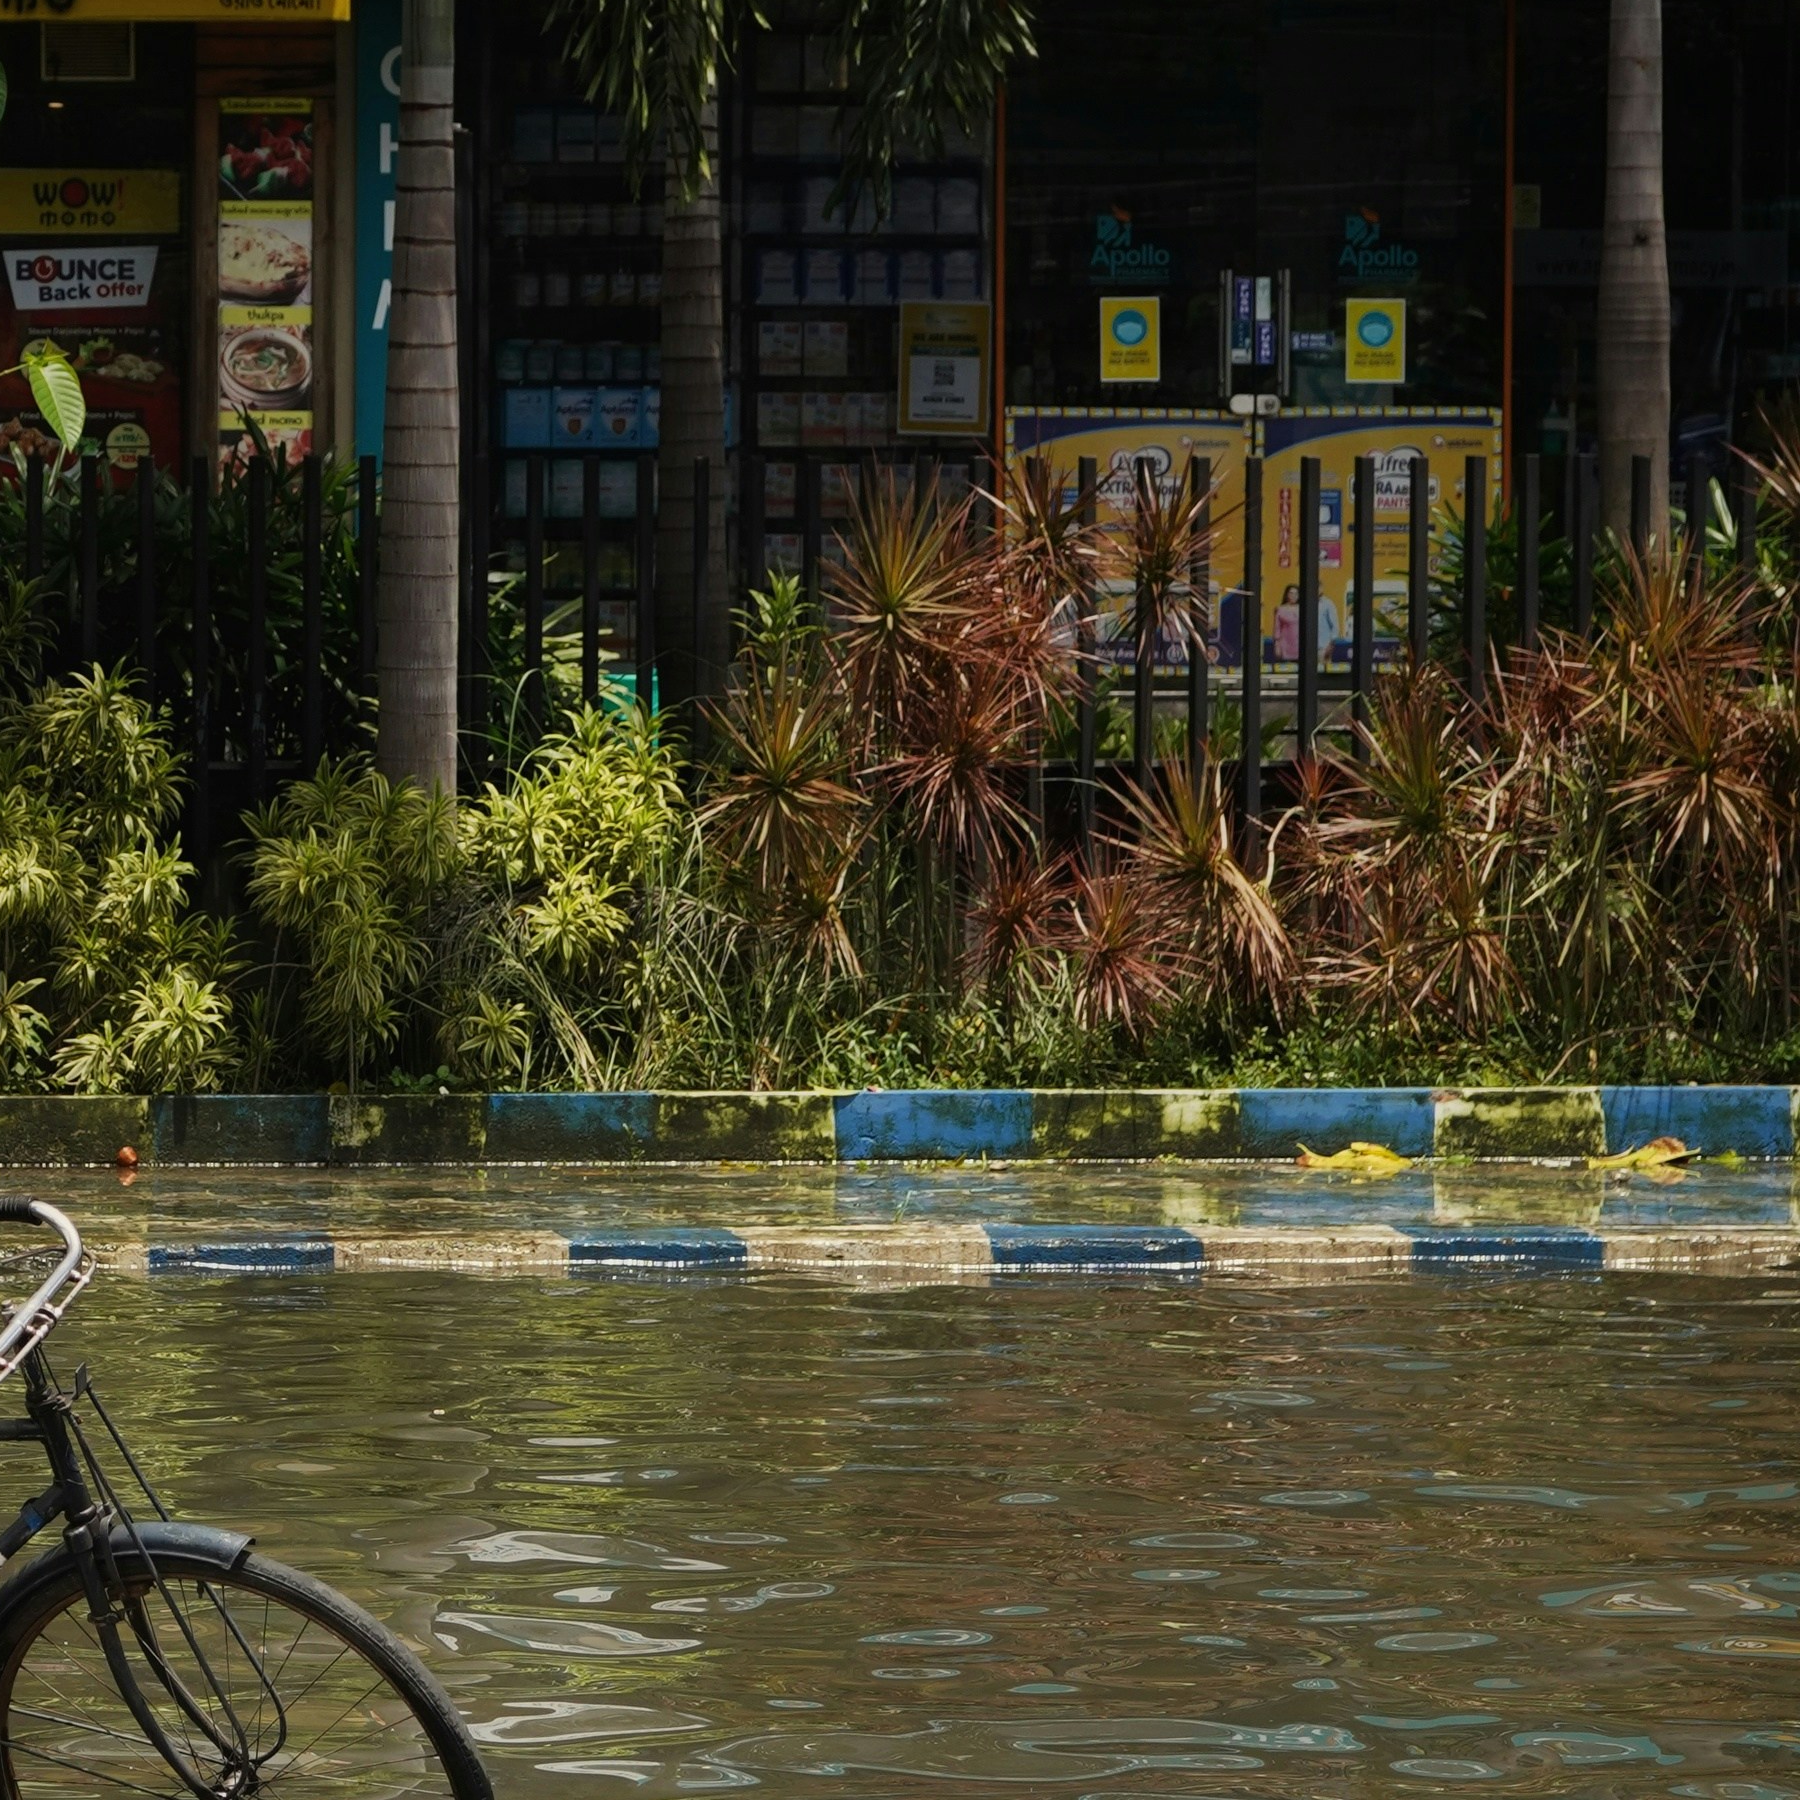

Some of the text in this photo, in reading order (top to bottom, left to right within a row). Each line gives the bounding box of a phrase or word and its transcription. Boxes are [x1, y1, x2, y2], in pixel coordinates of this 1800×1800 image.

[32, 177, 125, 210] WOW!
[39, 210, 117, 226] momo
[15, 255, 136, 283] BOUNCE
[1090, 242, 1171, 277] Apollo
[1338, 243, 1420, 277] Apollo
[38, 281, 145, 302] Back Offer
